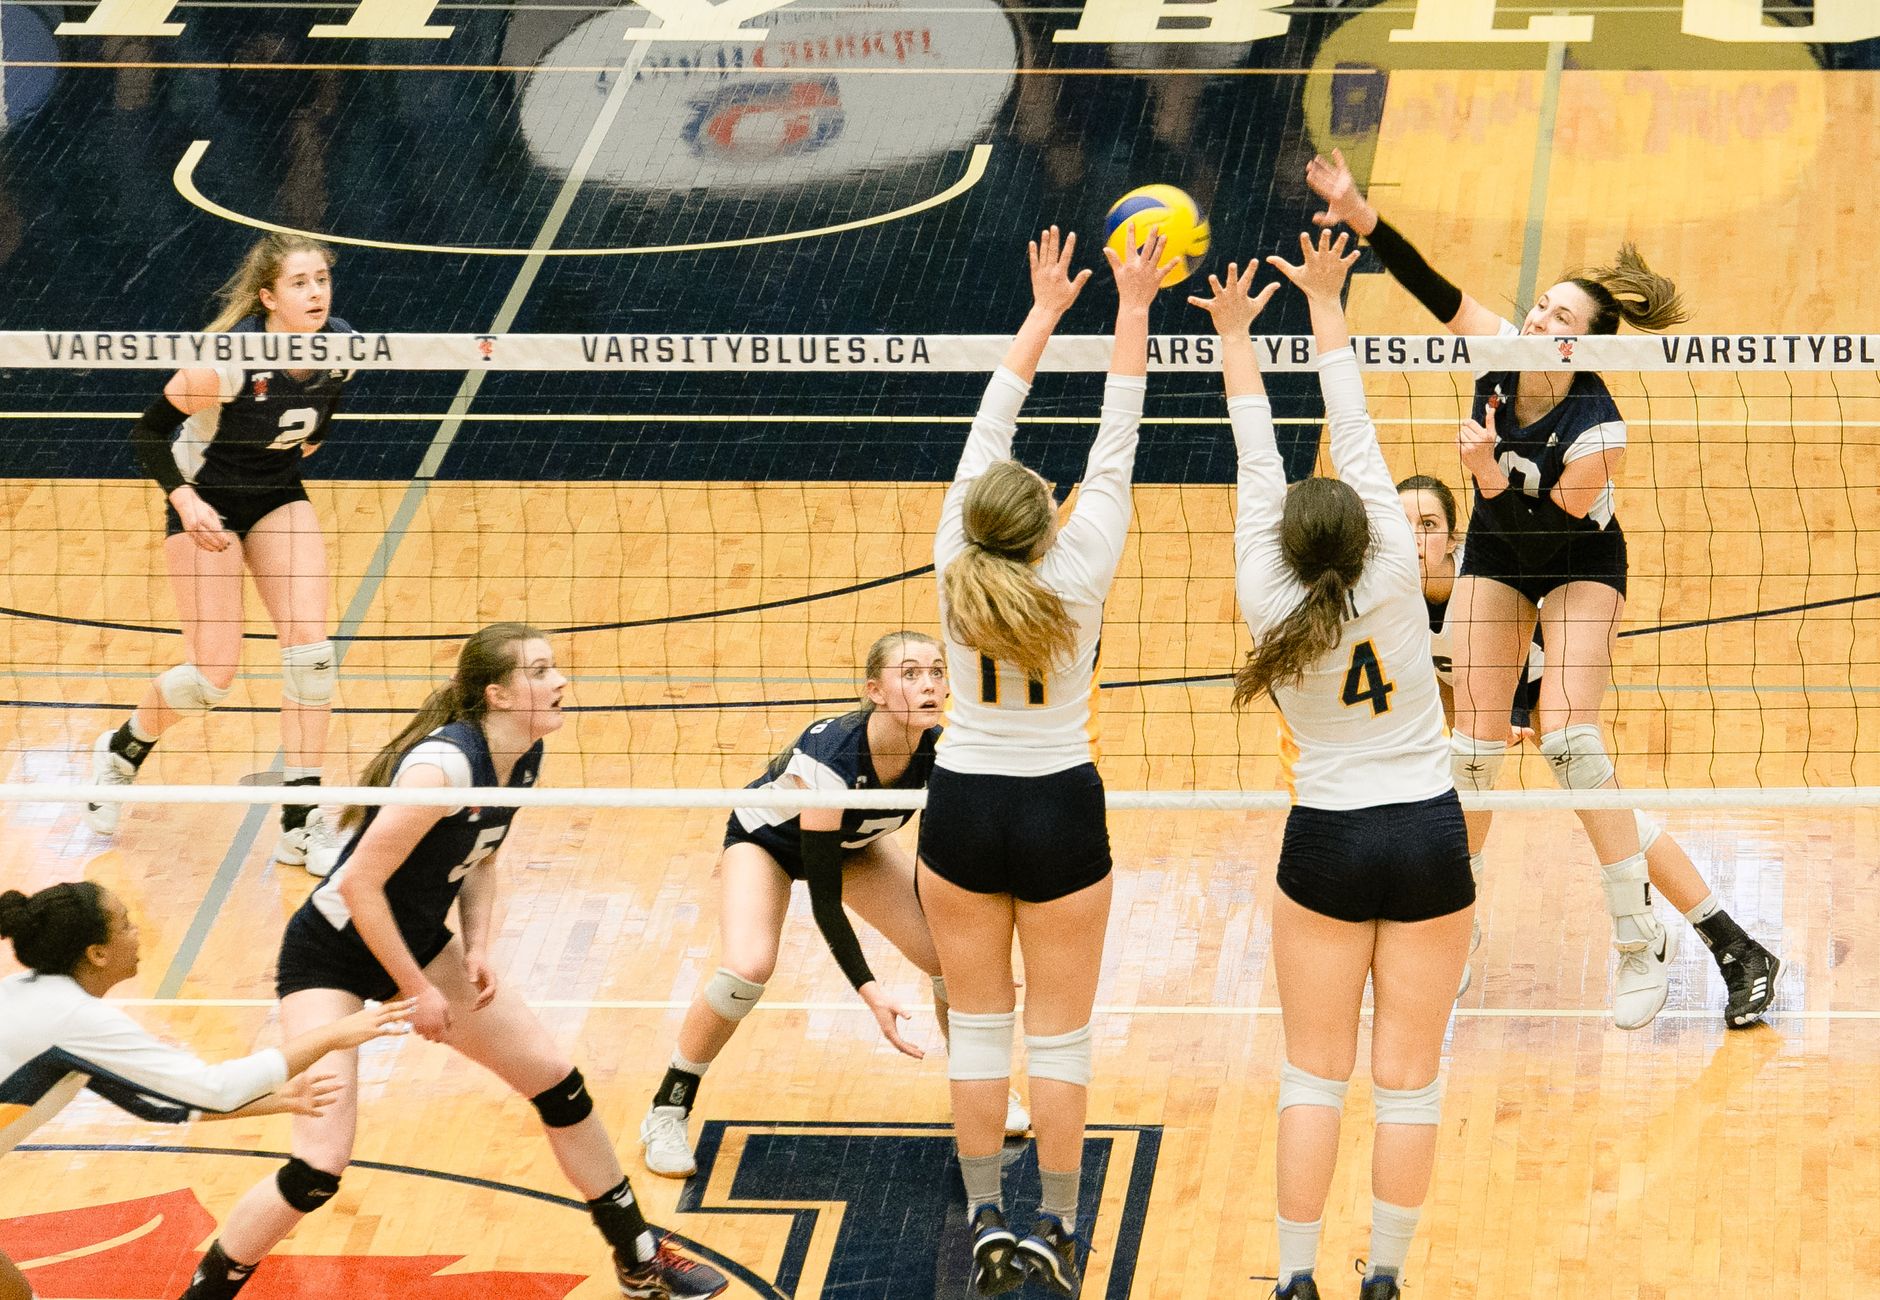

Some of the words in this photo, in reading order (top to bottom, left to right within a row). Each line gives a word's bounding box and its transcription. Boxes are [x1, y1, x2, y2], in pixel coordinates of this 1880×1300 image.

[46, 334, 393, 361] VARSITYBLUES.CA
[581, 336, 931, 363] VARSITYBLUES.CA
[1146, 336, 1472, 364] ARSYBES.CA
[1661, 336, 1875, 363] VARSITYBL
[265, 407, 319, 450] 2
[1337, 634, 1399, 720] 4
[840, 814, 905, 849] 7
[447, 824, 509, 883] 5
